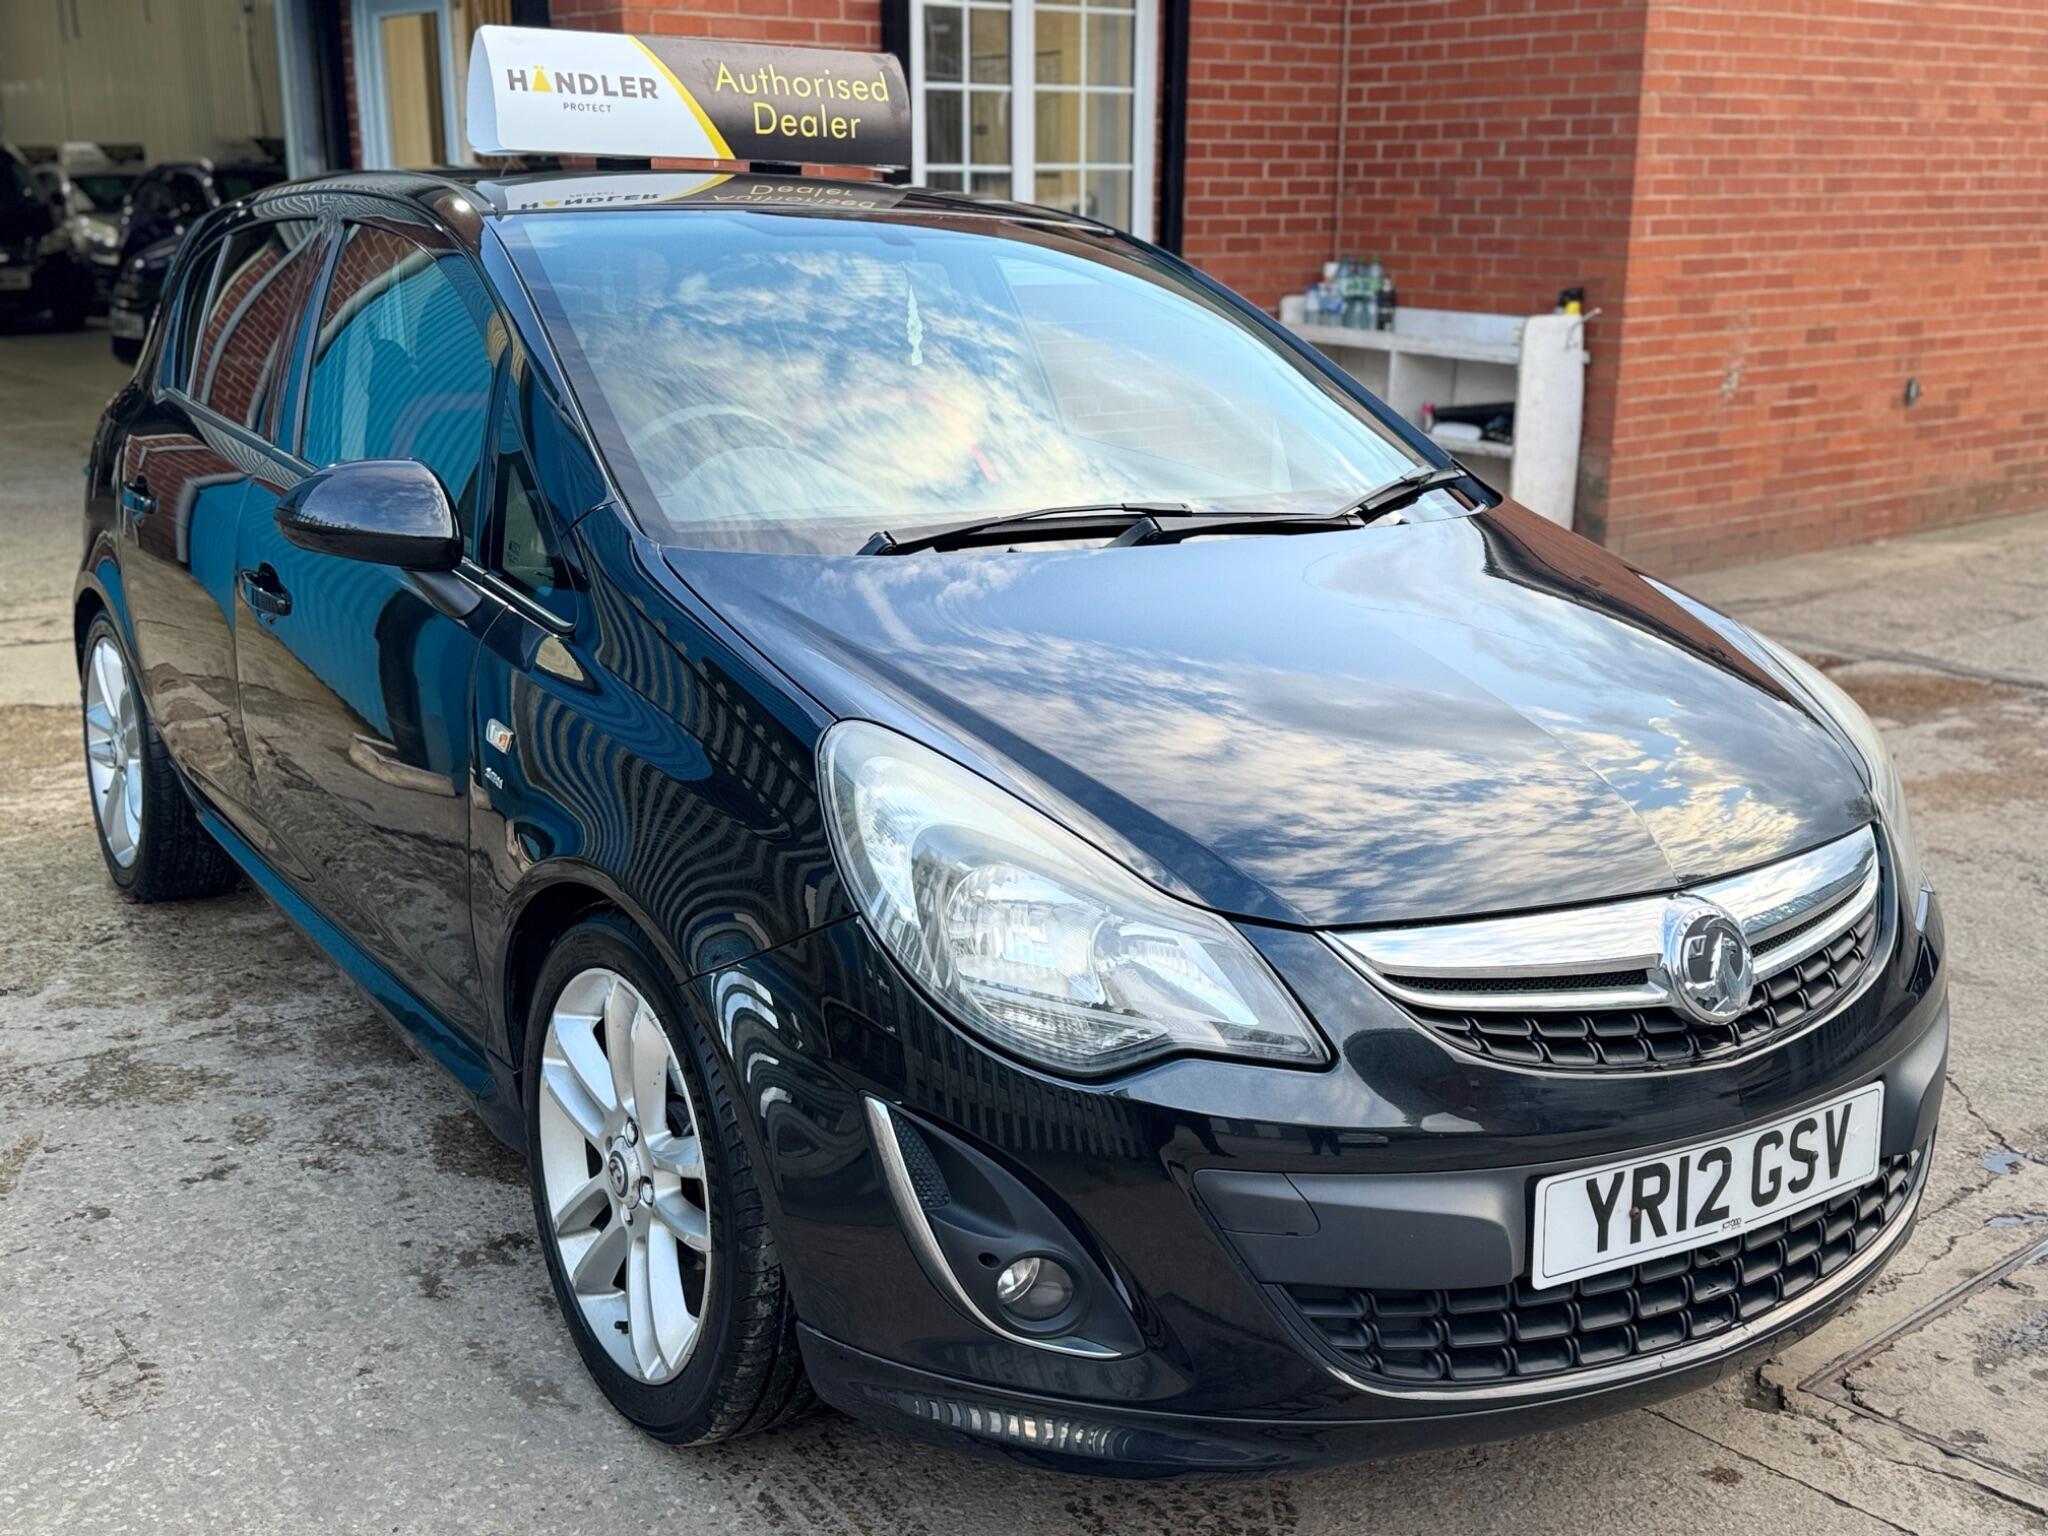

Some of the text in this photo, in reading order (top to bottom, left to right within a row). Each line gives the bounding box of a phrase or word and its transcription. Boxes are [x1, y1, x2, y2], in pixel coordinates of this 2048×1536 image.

[716, 62, 889, 102] Authorised
[563, 102, 611, 113] PROTECT
[753, 102, 861, 139] Dealer
[1586, 1102, 1853, 1253] YR12 GSV
